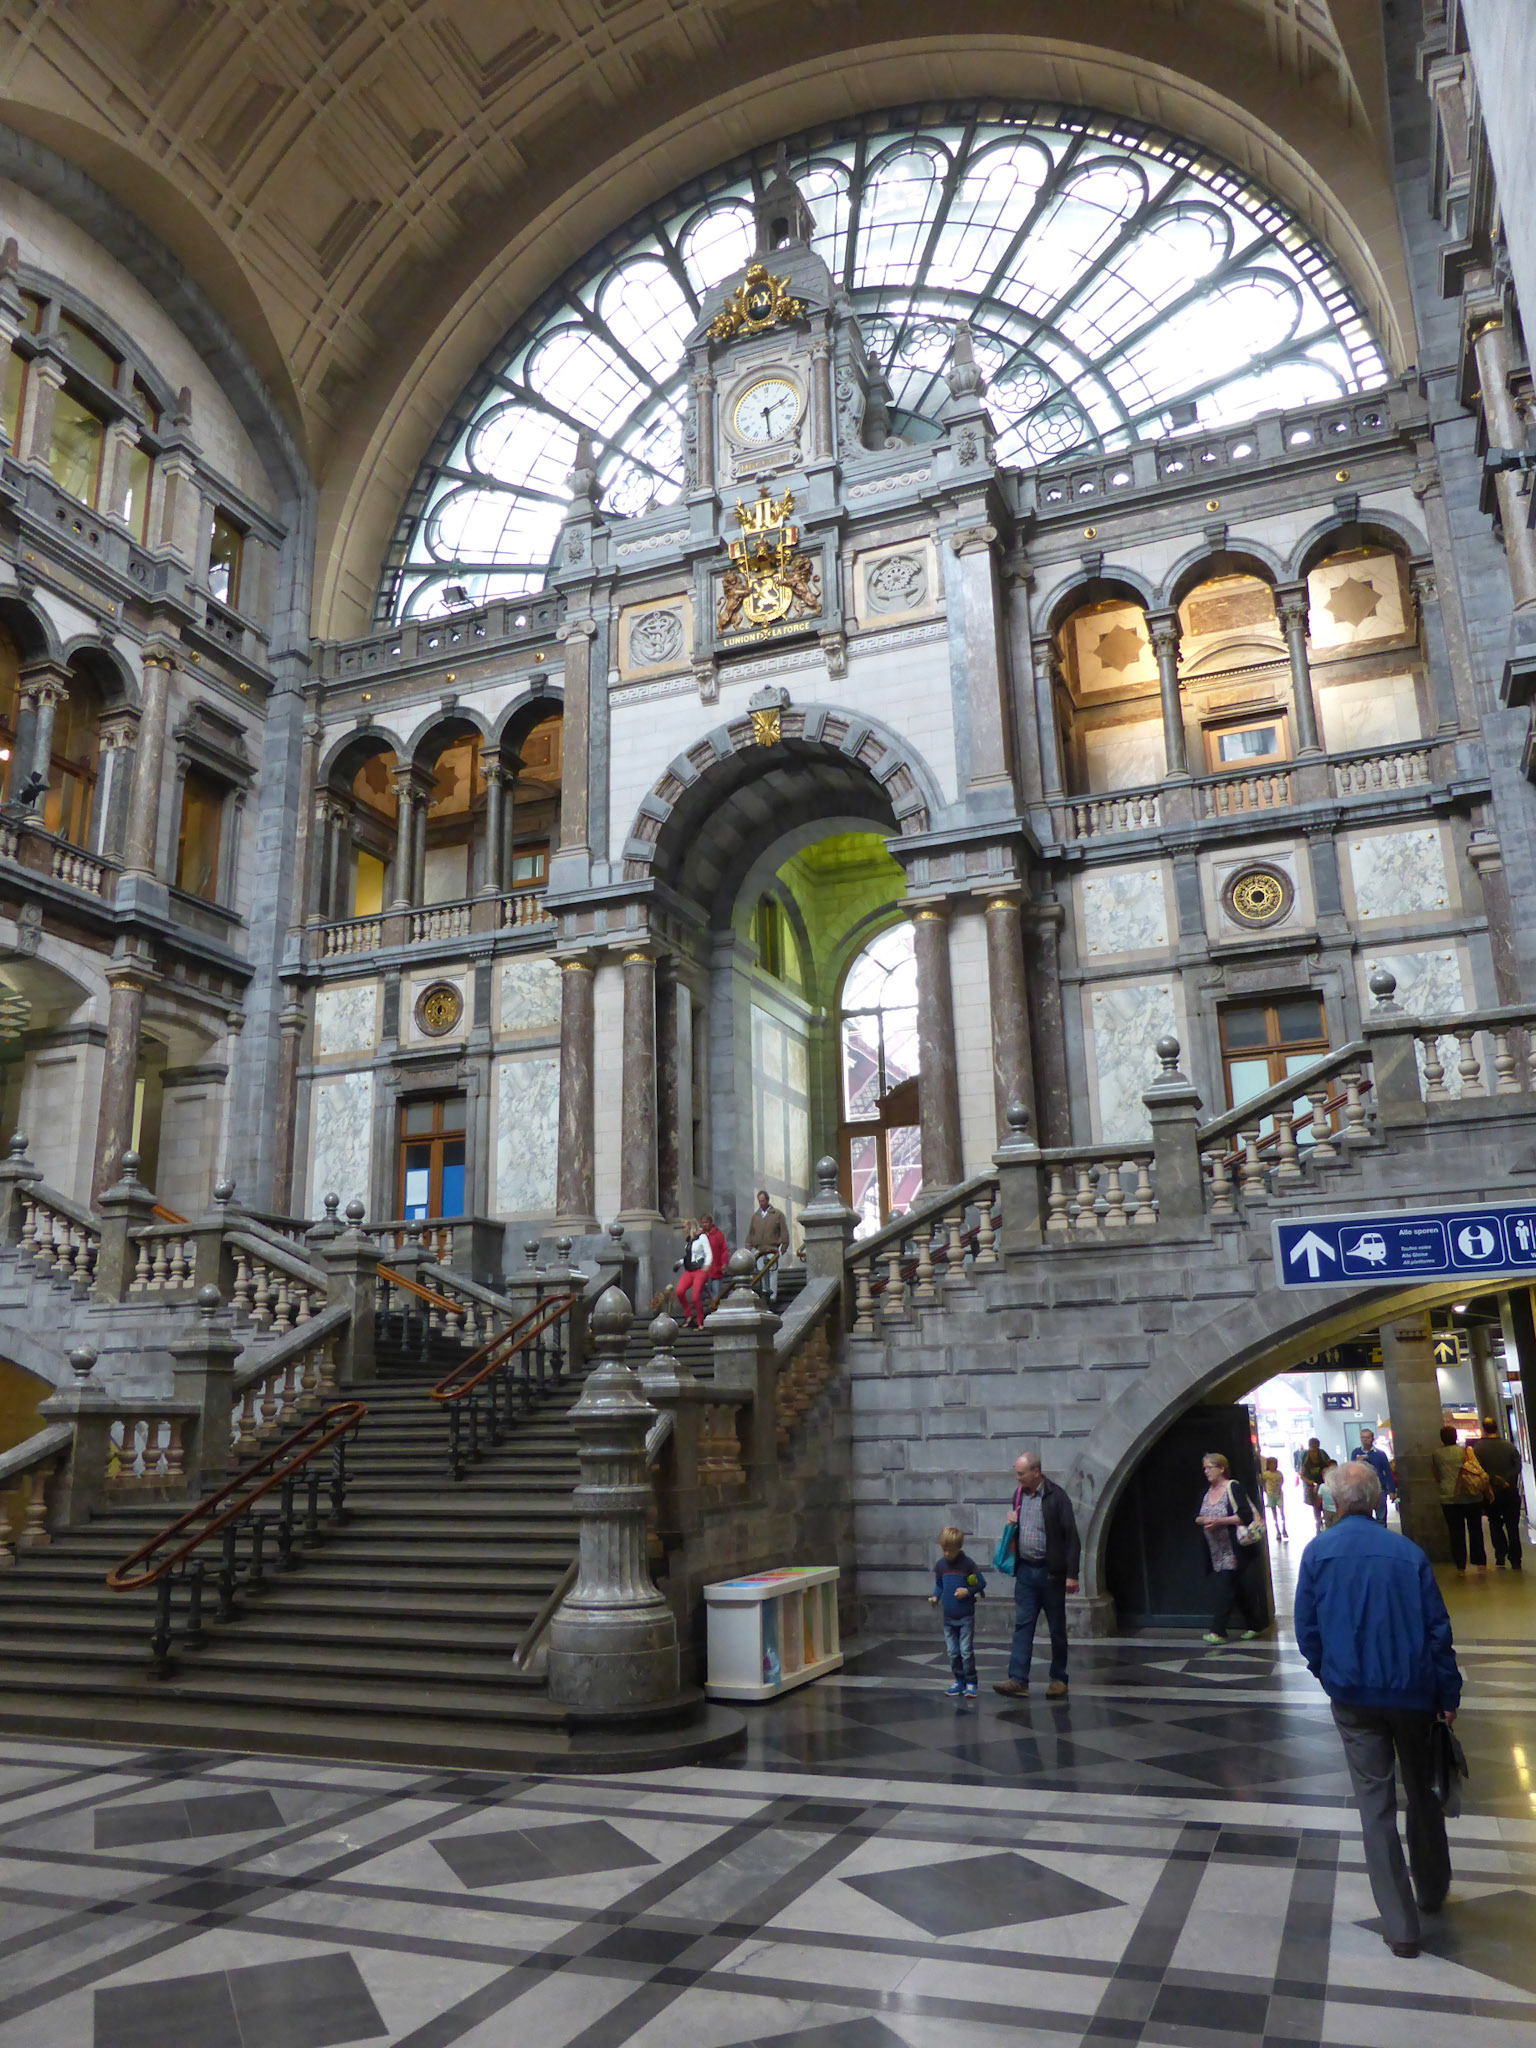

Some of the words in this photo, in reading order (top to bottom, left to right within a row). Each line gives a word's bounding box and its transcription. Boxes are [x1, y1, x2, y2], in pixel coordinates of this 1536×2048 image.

[747, 291, 771, 310] PAX
[772, 628, 782, 637] LA
[783, 622, 810, 634] FORCE
[1413, 1228, 1439, 1236] sporen
